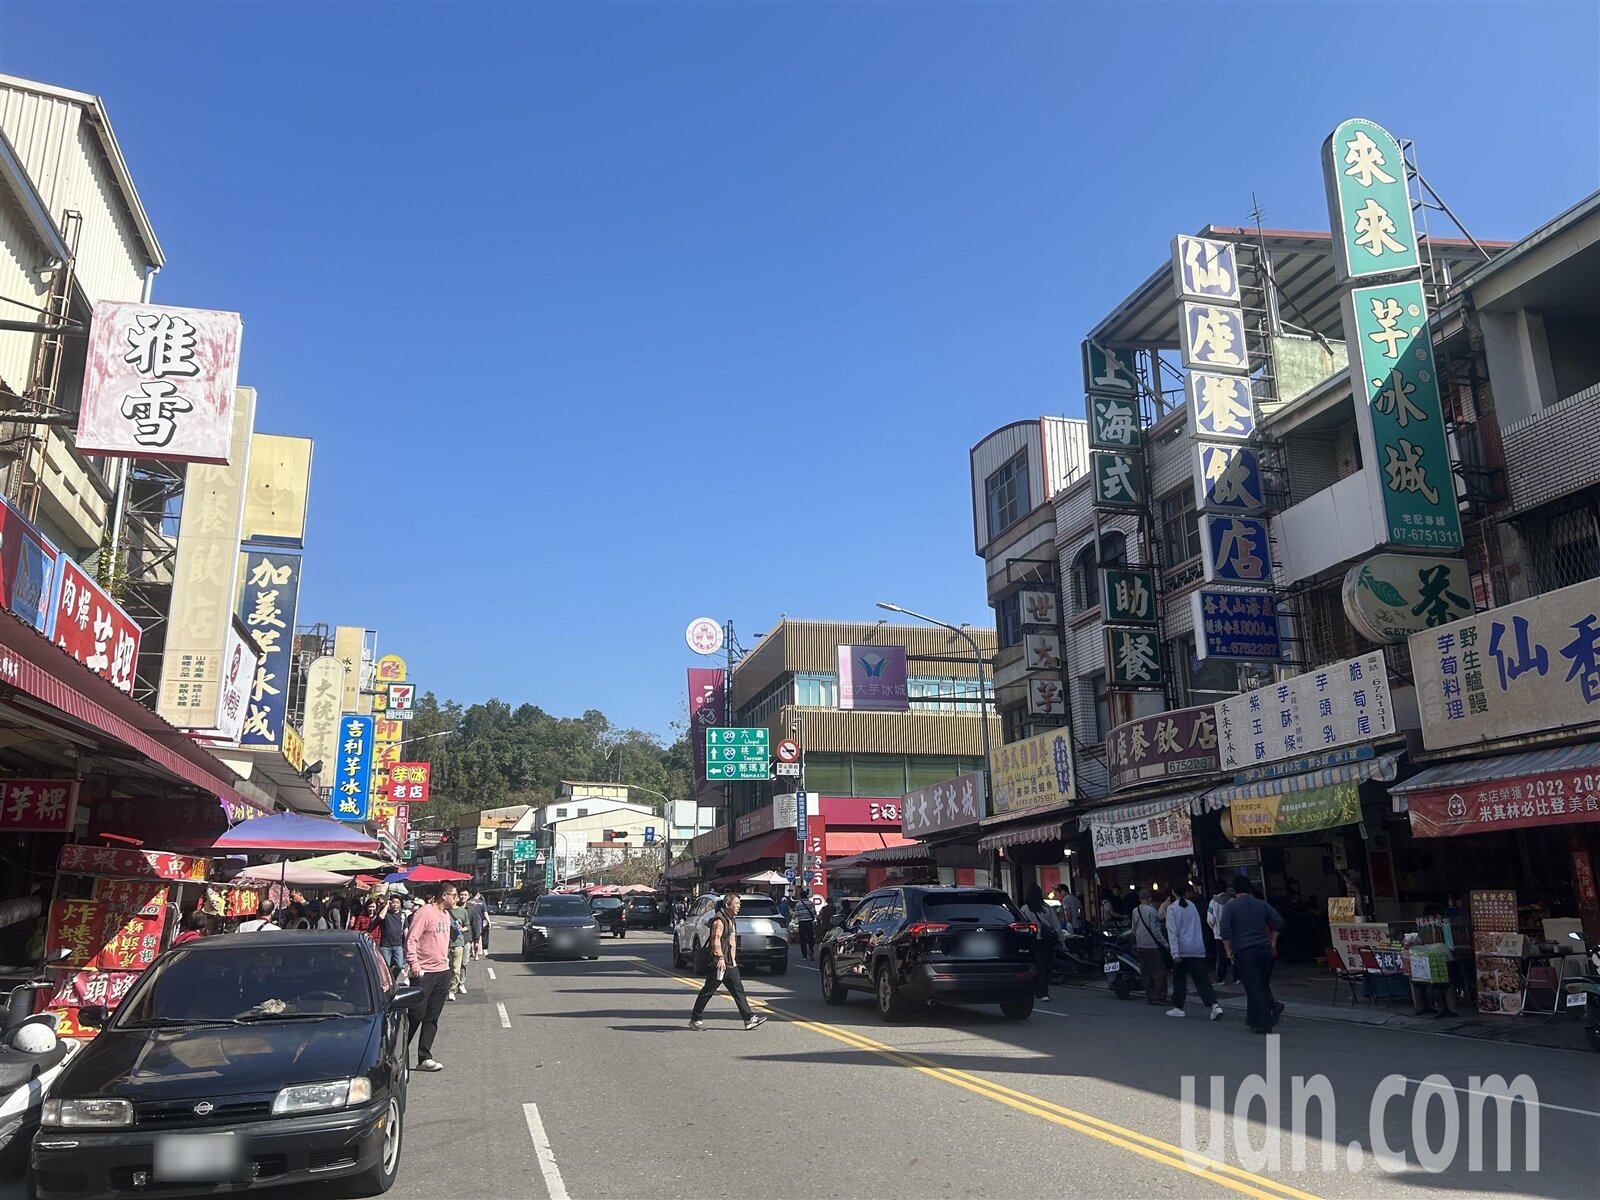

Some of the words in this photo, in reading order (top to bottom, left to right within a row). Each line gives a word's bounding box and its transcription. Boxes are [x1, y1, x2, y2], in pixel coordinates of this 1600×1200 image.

[1344, 130, 1439, 506] 來來芋冰城
[121, 313, 200, 447] 雅雪
[1186, 239, 1262, 579] 仙座餐飲店
[1094, 349, 1138, 501] 上海式
[1393, 527, 1459, 542] 07-6751311
[1115, 576, 1159, 681] 助餐
[1411, 564, 1470, 628] 茶
[1027, 590, 1061, 713] 世大芋
[1437, 633, 1465, 720] 芋筍料理
[1459, 626, 1489, 715] 野生鱸鰻
[841, 683, 908, 697] 世大芋冰城
[1277, 685, 1297, 753] 芋酥條
[1315, 672, 1336, 744] 芋頭乳
[1249, 694, 1266, 760] 紫玉酥
[339, 719, 366, 815] 吉利芋冰城
[392, 766, 428, 783] 芋冰
[392, 785, 424, 799] 老店
[1170, 757, 1214, 771] 6752287
[1526, 779, 1565, 799] 2022
[7, 786, 67, 822] 芋粿
[904, 778, 977, 831] 世大芋冰城
[59, 903, 98, 965] 炸蟋蟀
[1338, 927, 1383, 942] 顆粒芋冰
